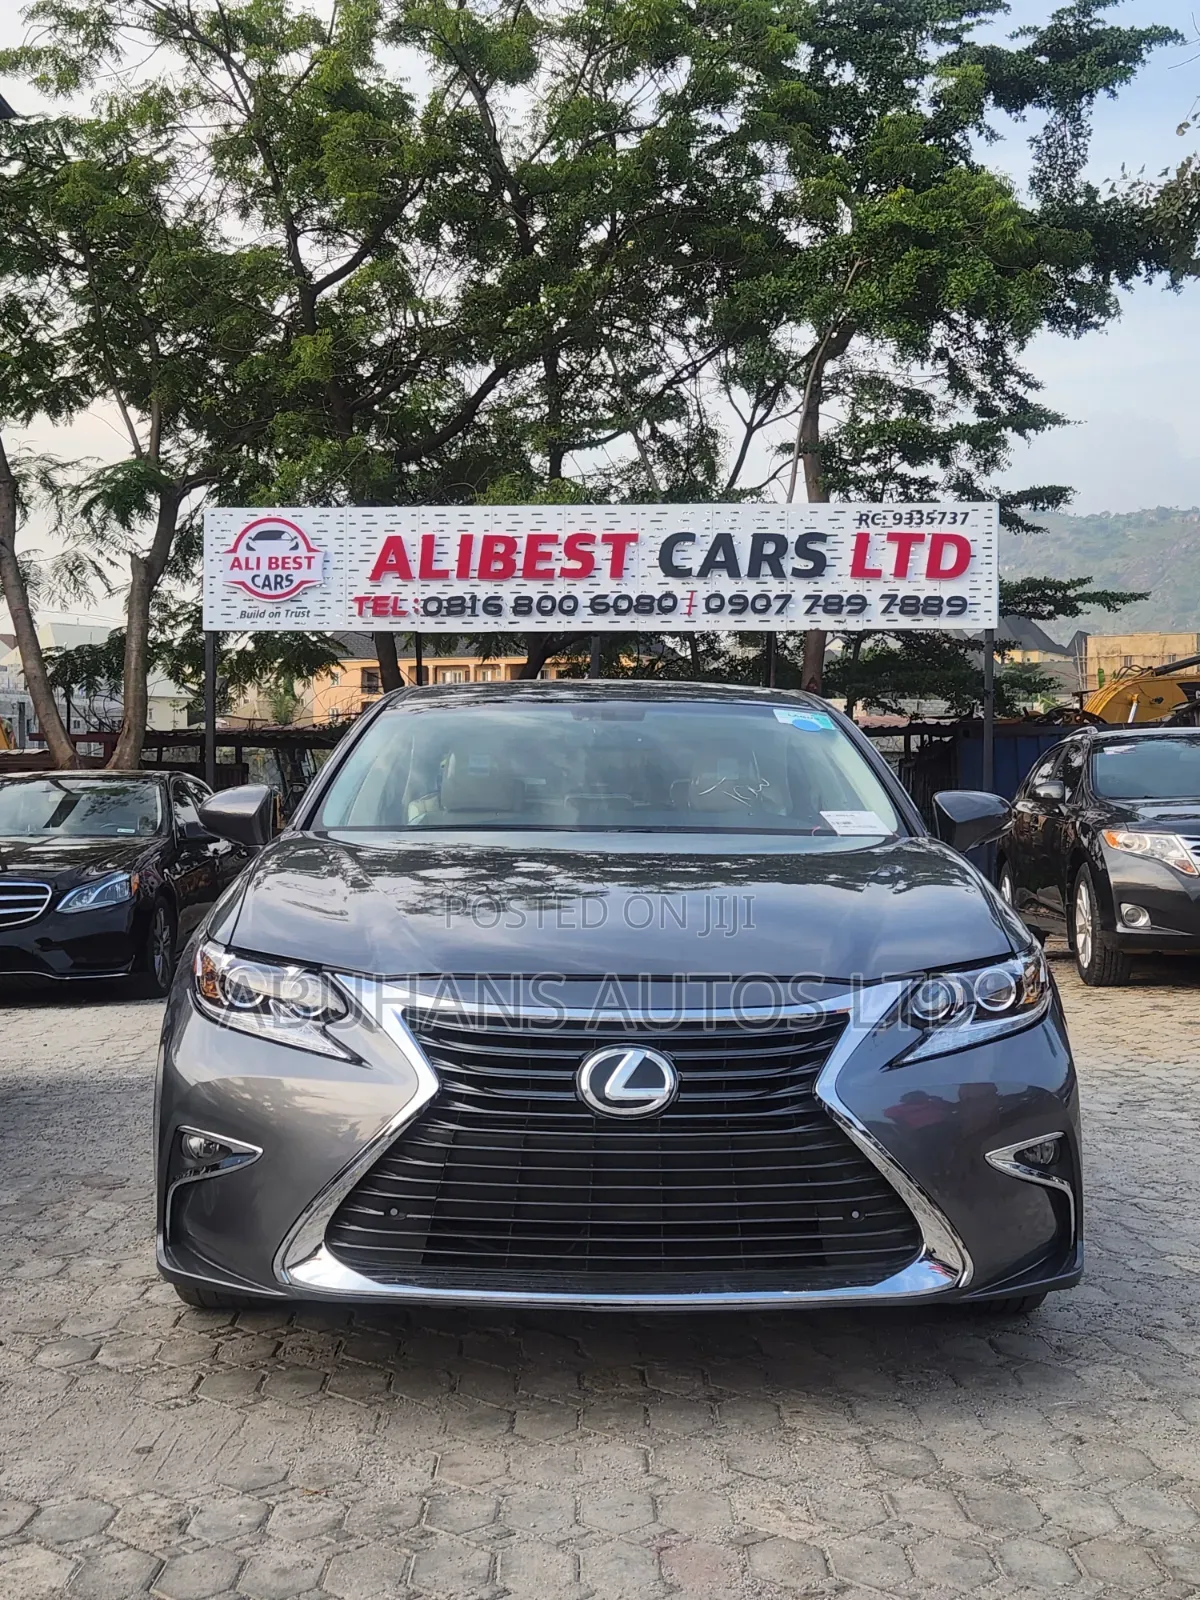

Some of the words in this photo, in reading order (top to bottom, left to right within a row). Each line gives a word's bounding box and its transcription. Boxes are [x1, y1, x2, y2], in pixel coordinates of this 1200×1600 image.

[892, 511, 970, 526] 9335737
[229, 555, 261, 571] ALI
[267, 555, 316, 571] BEST
[368, 532, 639, 582] ALIBEST
[658, 531, 829, 580] CARS
[849, 531, 973, 581] LTD
[251, 573, 294, 592] CARS
[422, 594, 504, 618] 0816
[512, 594, 579, 617] 800
[589, 593, 678, 616] 6080
[704, 592, 793, 615] 0907
[802, 593, 869, 616] 789
[879, 593, 968, 616] 7889
[239, 609, 267, 619] Build
[268, 610, 282, 619] on
[285, 609, 311, 618] Trust
